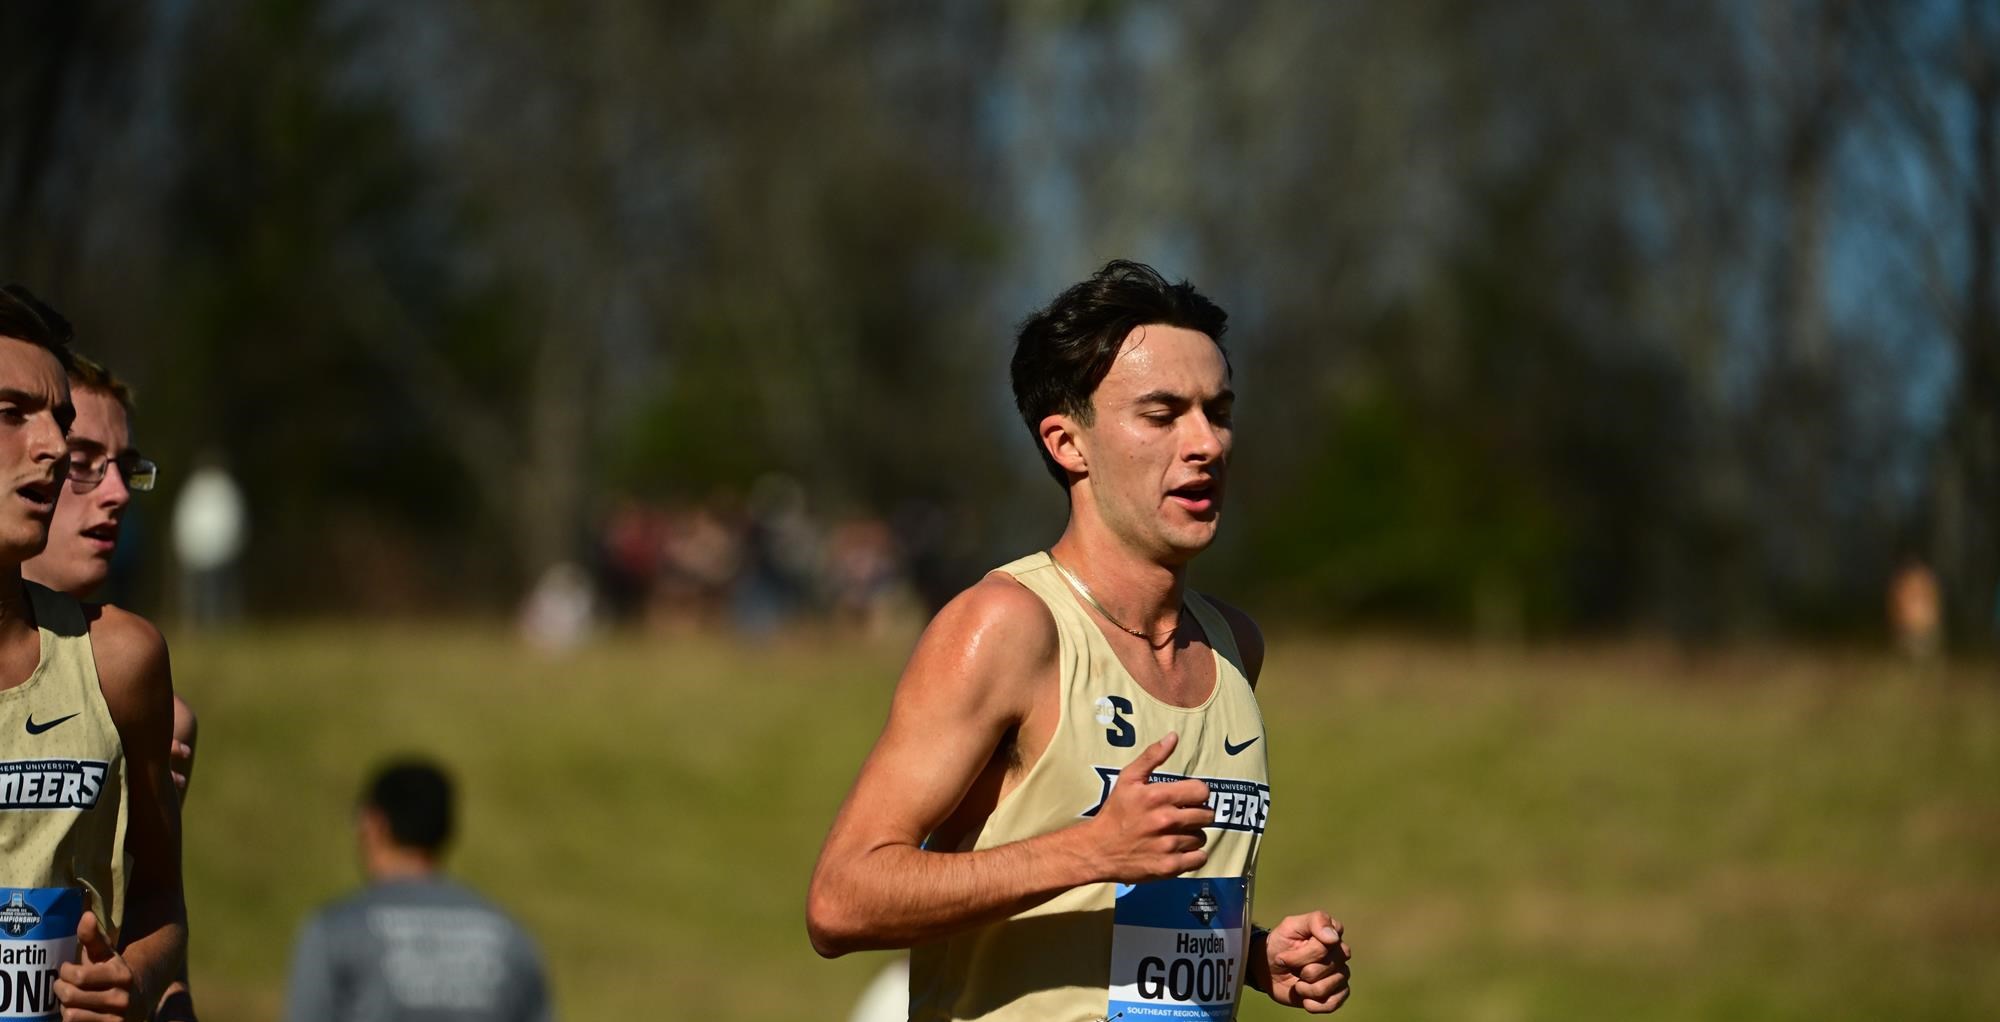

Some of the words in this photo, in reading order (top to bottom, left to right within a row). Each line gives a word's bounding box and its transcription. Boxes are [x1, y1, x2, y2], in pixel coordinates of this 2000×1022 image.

[1106, 696, 1136, 747] S
[1221, 783, 1255, 792] UNIVERSITY
[0, 944, 47, 965] artin
[1176, 932, 1225, 958] Hayden
[1137, 956, 1234, 1002] GOODE
[1127, 1006, 1172, 1017] SOUTHEAST
